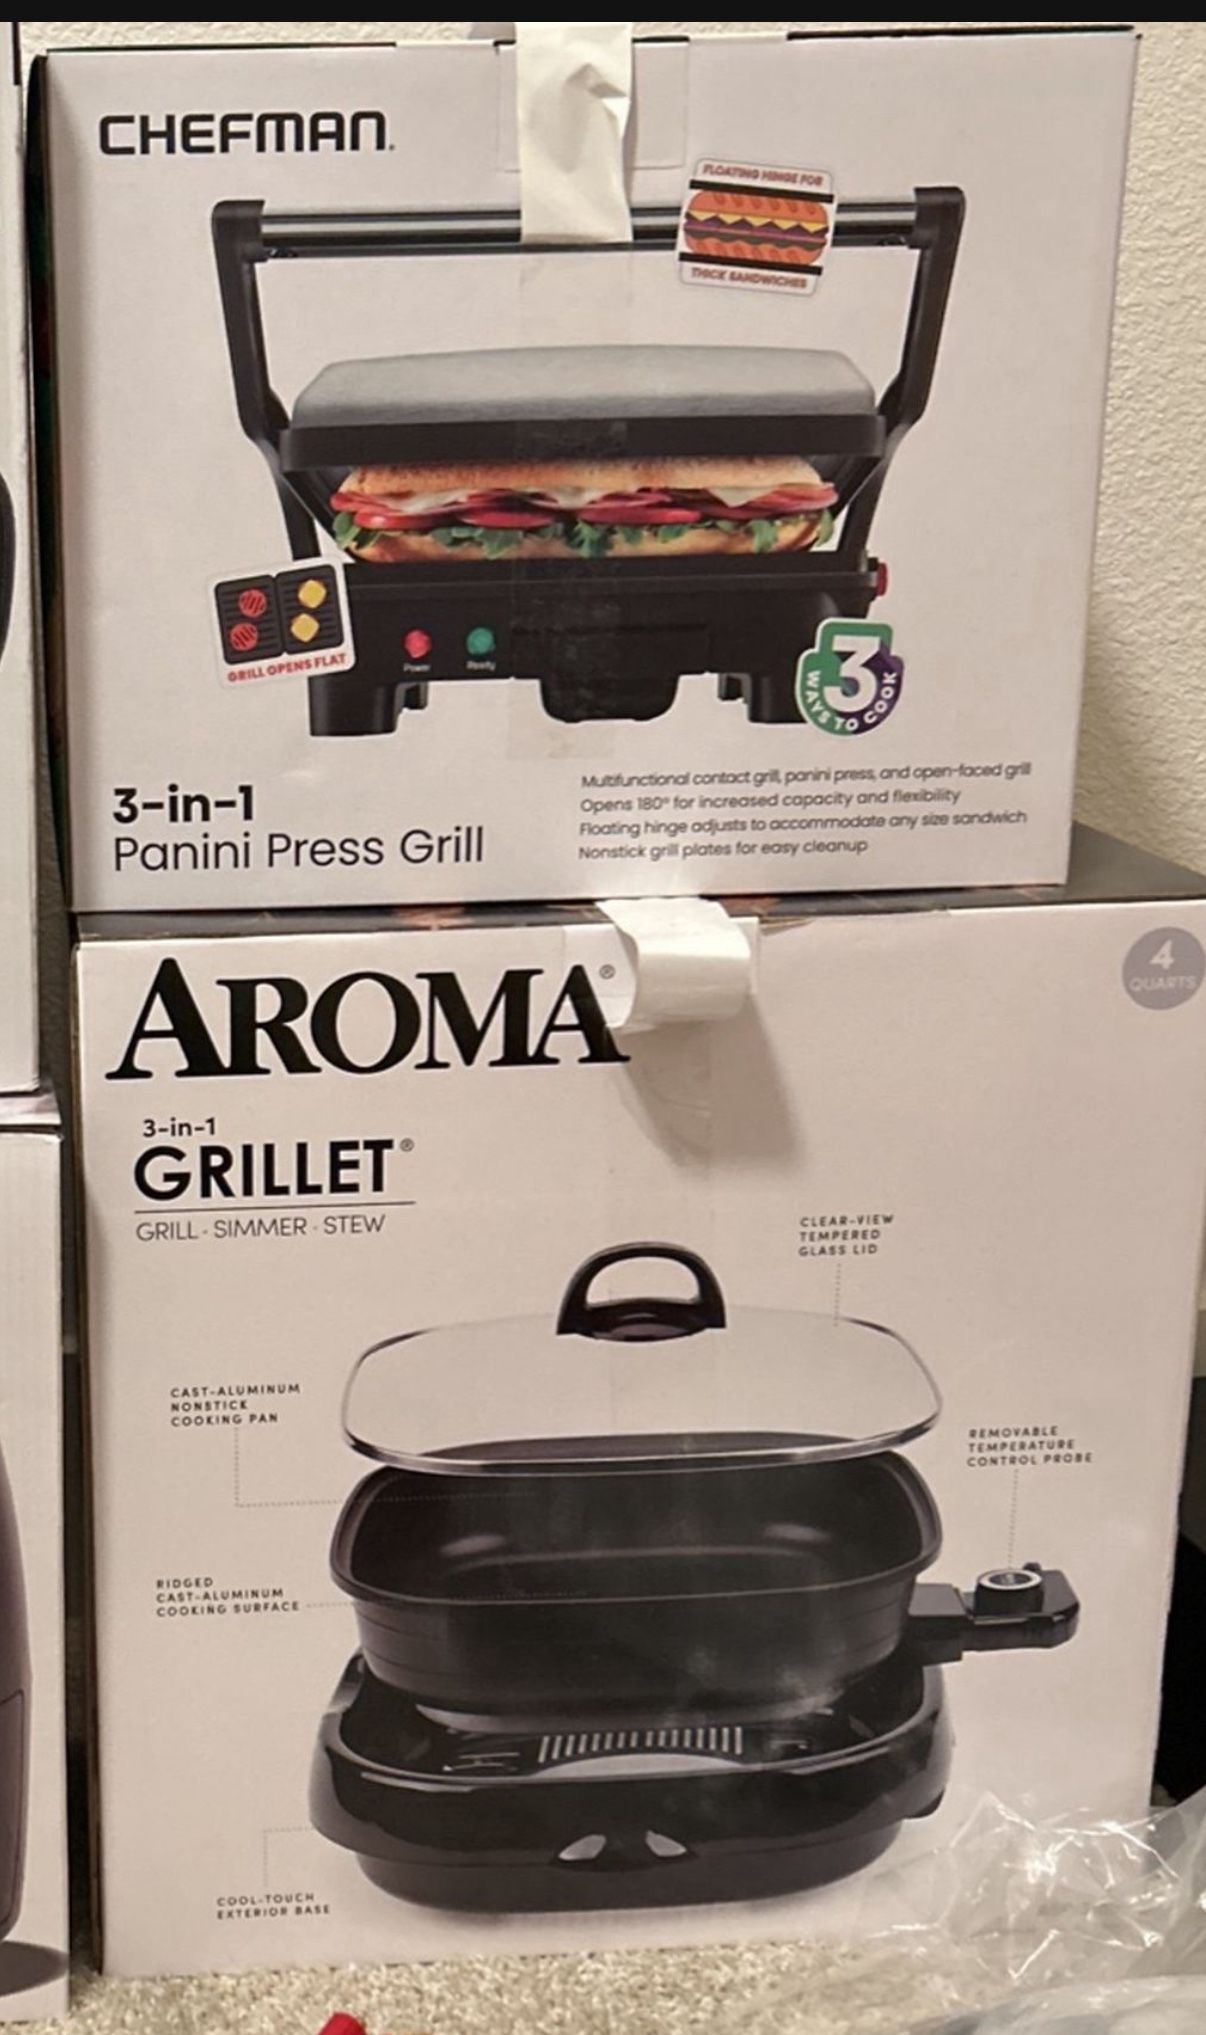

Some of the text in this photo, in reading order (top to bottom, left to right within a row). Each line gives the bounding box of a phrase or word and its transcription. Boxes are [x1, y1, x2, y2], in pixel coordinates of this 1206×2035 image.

[99, 110, 386, 155] CHEFMAN
[702, 164, 824, 186] FLOATING HINGE FOR
[690, 267, 808, 289] THICK SANDWICHES
[227, 653, 347, 682] GRILL OPENS FLAT
[823, 634, 880, 713] 3
[805, 670, 898, 732] WAYS TO COOK
[581, 762, 1032, 788] Multifunctional contact grill, panini press, and open-faced grill
[113, 783, 254, 824] 3-in-1
[580, 788, 961, 815] Opens 180° for increased capacity and flexibility
[579, 810, 1028, 838] Floating hinge adjusts to accommodate any size sandwich
[114, 825, 484, 872] Panini Press Grill
[578, 839, 869, 861] Nonstick grill plates for easy cleanup
[1149, 939, 1175, 970] 4
[1128, 976, 1197, 991] QUARTS
[142, 1117, 216, 1138] 3-in-1
[136, 1214, 386, 1242] GRILL SIMMER STEW
[799, 1214, 894, 1228] CLEAR-VIEW
[799, 1229, 881, 1242] TEMPERED
[798, 1243, 878, 1257] GLASS LID
[170, 1383, 301, 1398] CAST-ALUMINUM
[170, 1400, 248, 1413] NONSTICK
[170, 1412, 279, 1428] COOKING PAN
[968, 1425, 1059, 1438] REMOVABLE
[968, 1439, 1075, 1453] TEMPERATURE
[966, 1452, 1093, 1467] CONTROL PROBE
[155, 1577, 214, 1589] RIDGED
[155, 1588, 284, 1604] CAST-ALUMINUM
[155, 1600, 300, 1618] COOKING SURFACE
[216, 1892, 315, 1908] COOL-TOUCH
[216, 1904, 331, 1921] EXTERIOR BASE
